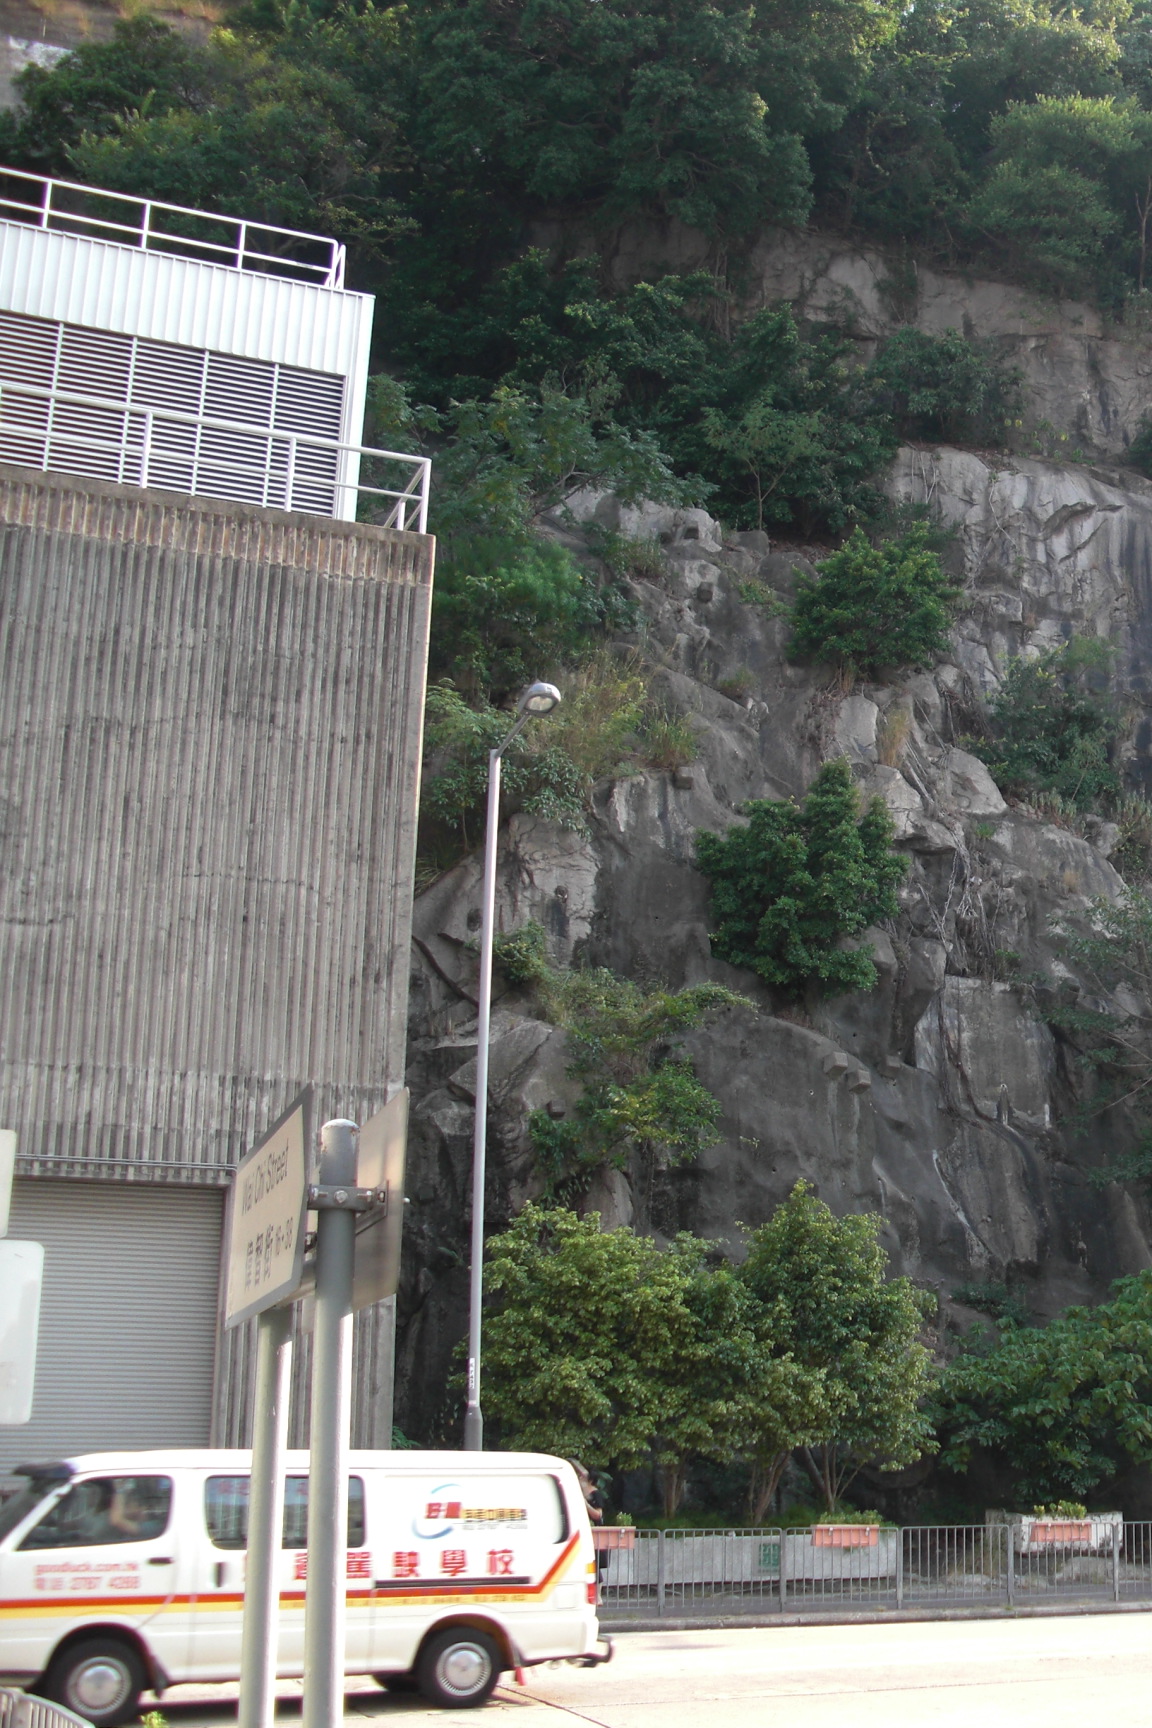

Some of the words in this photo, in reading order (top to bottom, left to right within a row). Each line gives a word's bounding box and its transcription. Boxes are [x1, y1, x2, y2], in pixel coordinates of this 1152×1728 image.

[241, 1174, 254, 1216] Wai
[254, 1162, 265, 1204] Chi
[266, 1138, 289, 1194] Street
